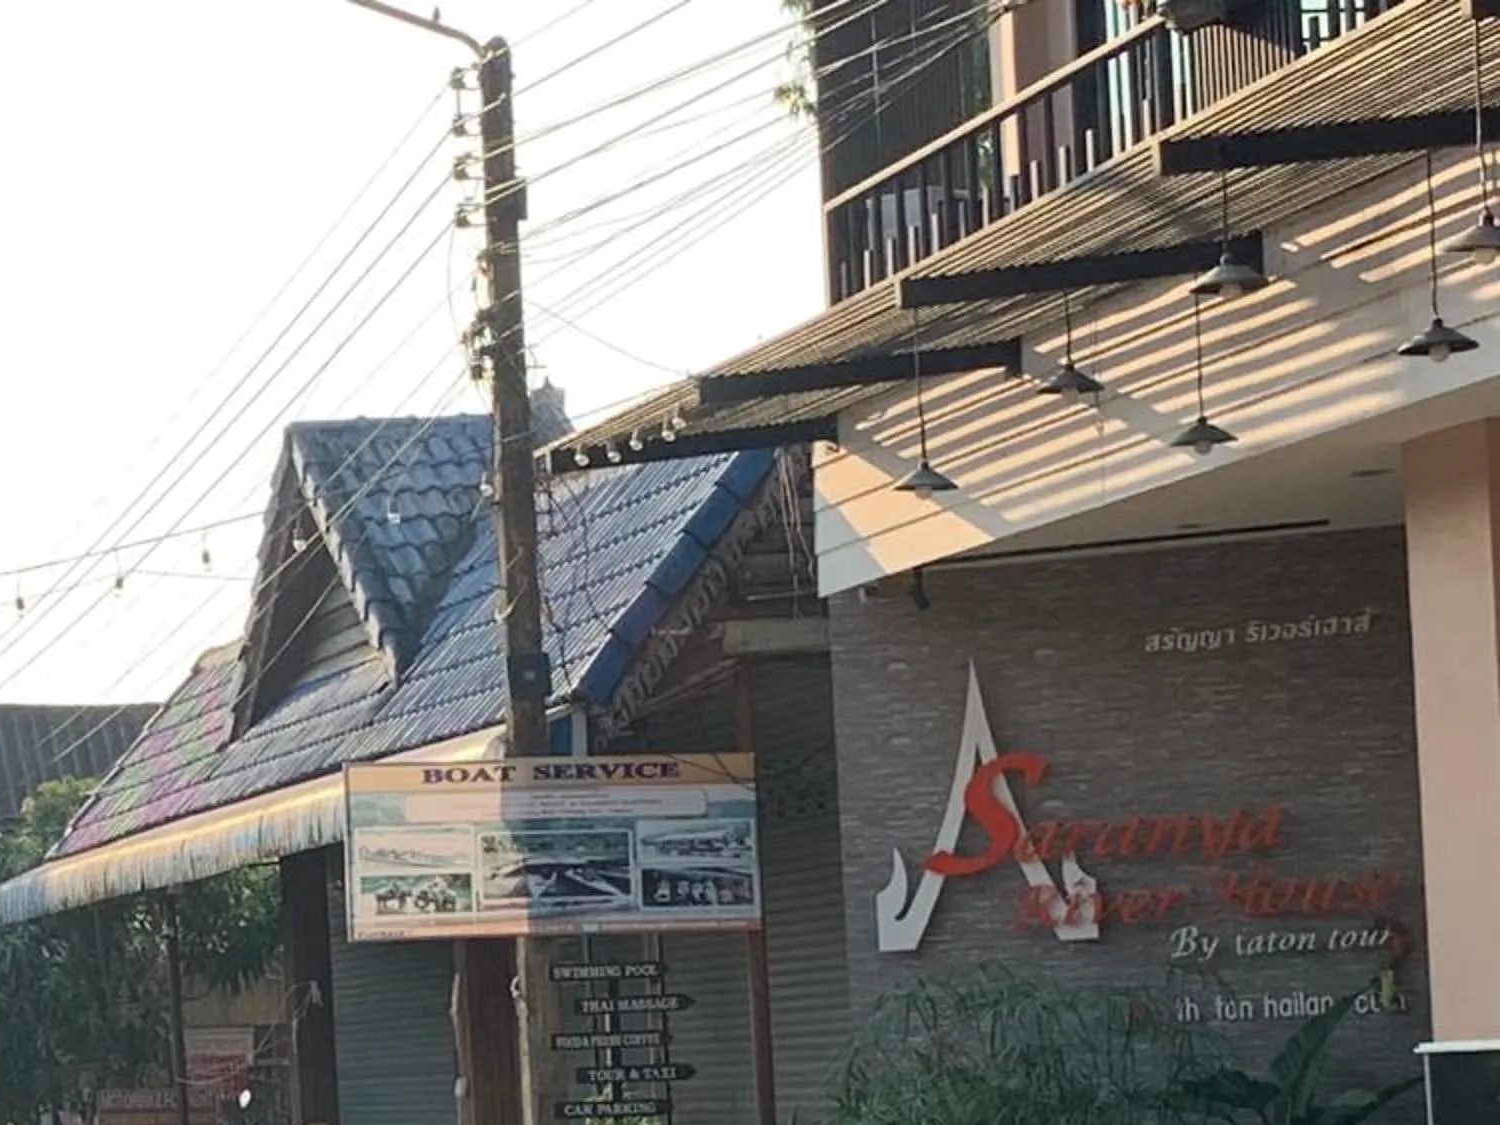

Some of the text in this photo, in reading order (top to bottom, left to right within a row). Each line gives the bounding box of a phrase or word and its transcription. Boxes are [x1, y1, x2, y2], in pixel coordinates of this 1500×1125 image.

[422, 761, 681, 785] BOAT SERVICE
[1169, 926, 1219, 961] By
